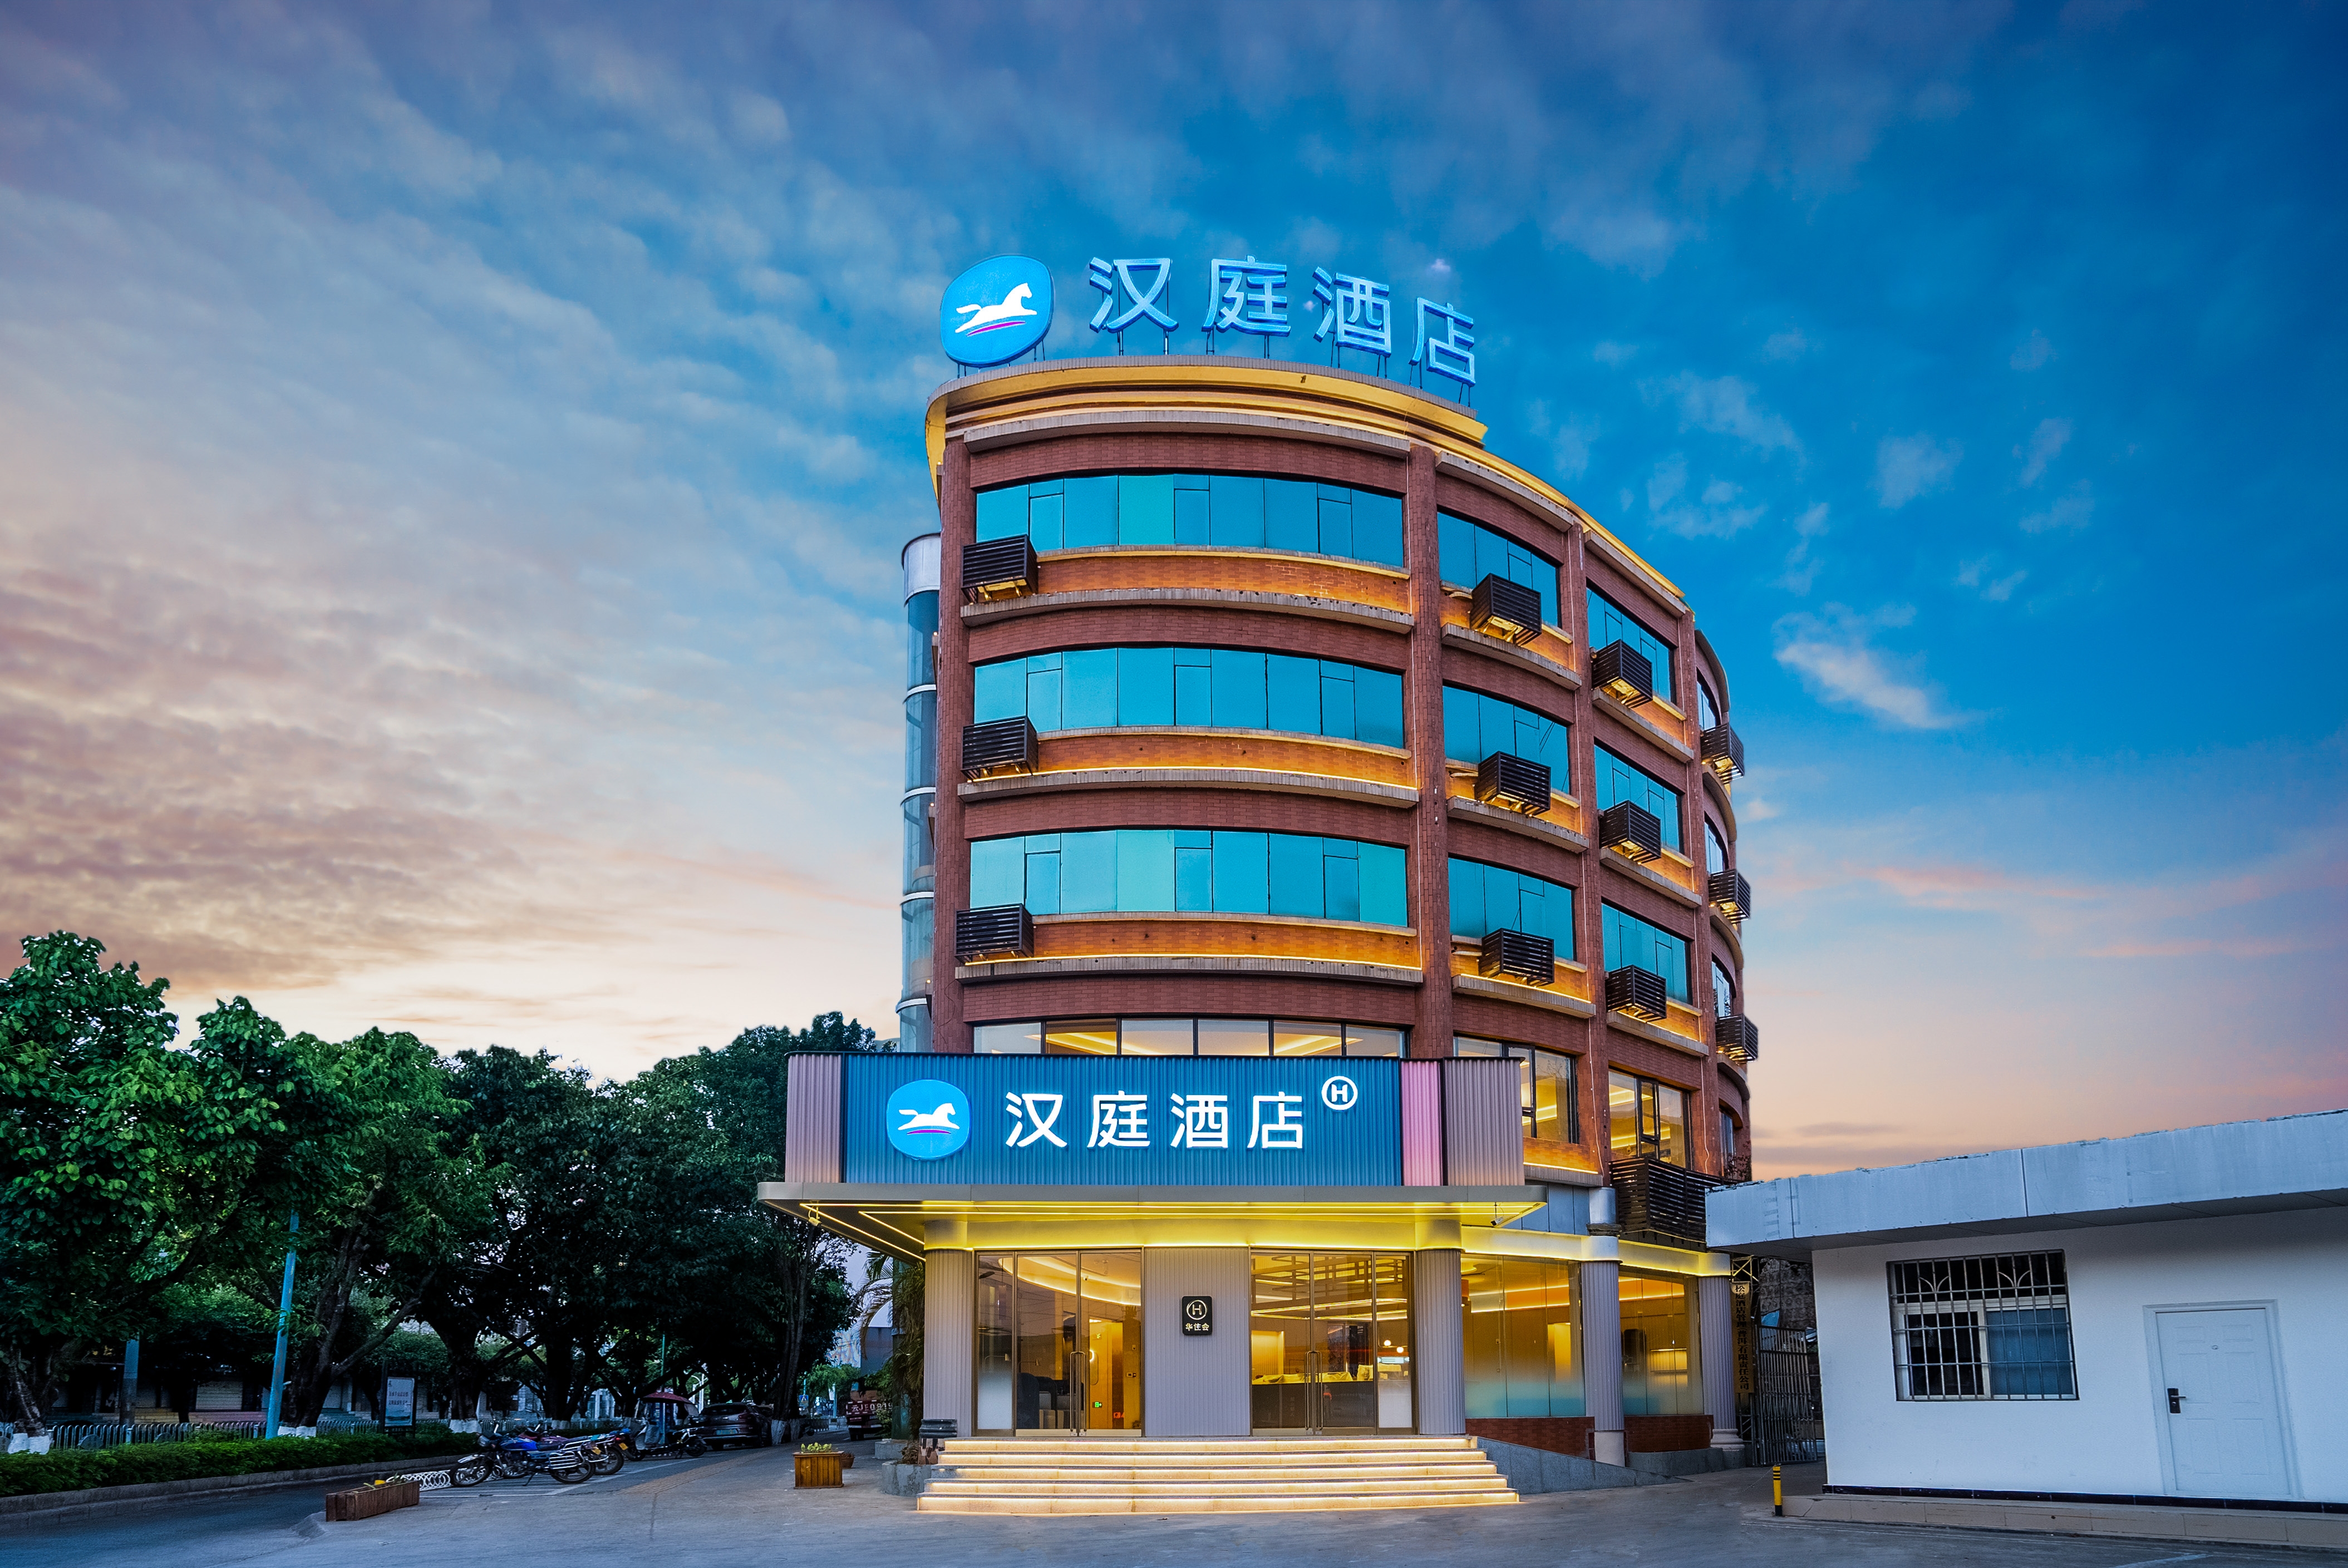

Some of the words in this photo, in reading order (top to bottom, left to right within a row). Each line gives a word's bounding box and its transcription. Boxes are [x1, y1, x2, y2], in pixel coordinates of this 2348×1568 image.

[1089, 255, 1476, 388] 汉庭酒店
[1005, 1091, 1305, 1149] 汉庭酒店
[1185, 1323, 1209, 1332] 华住会
